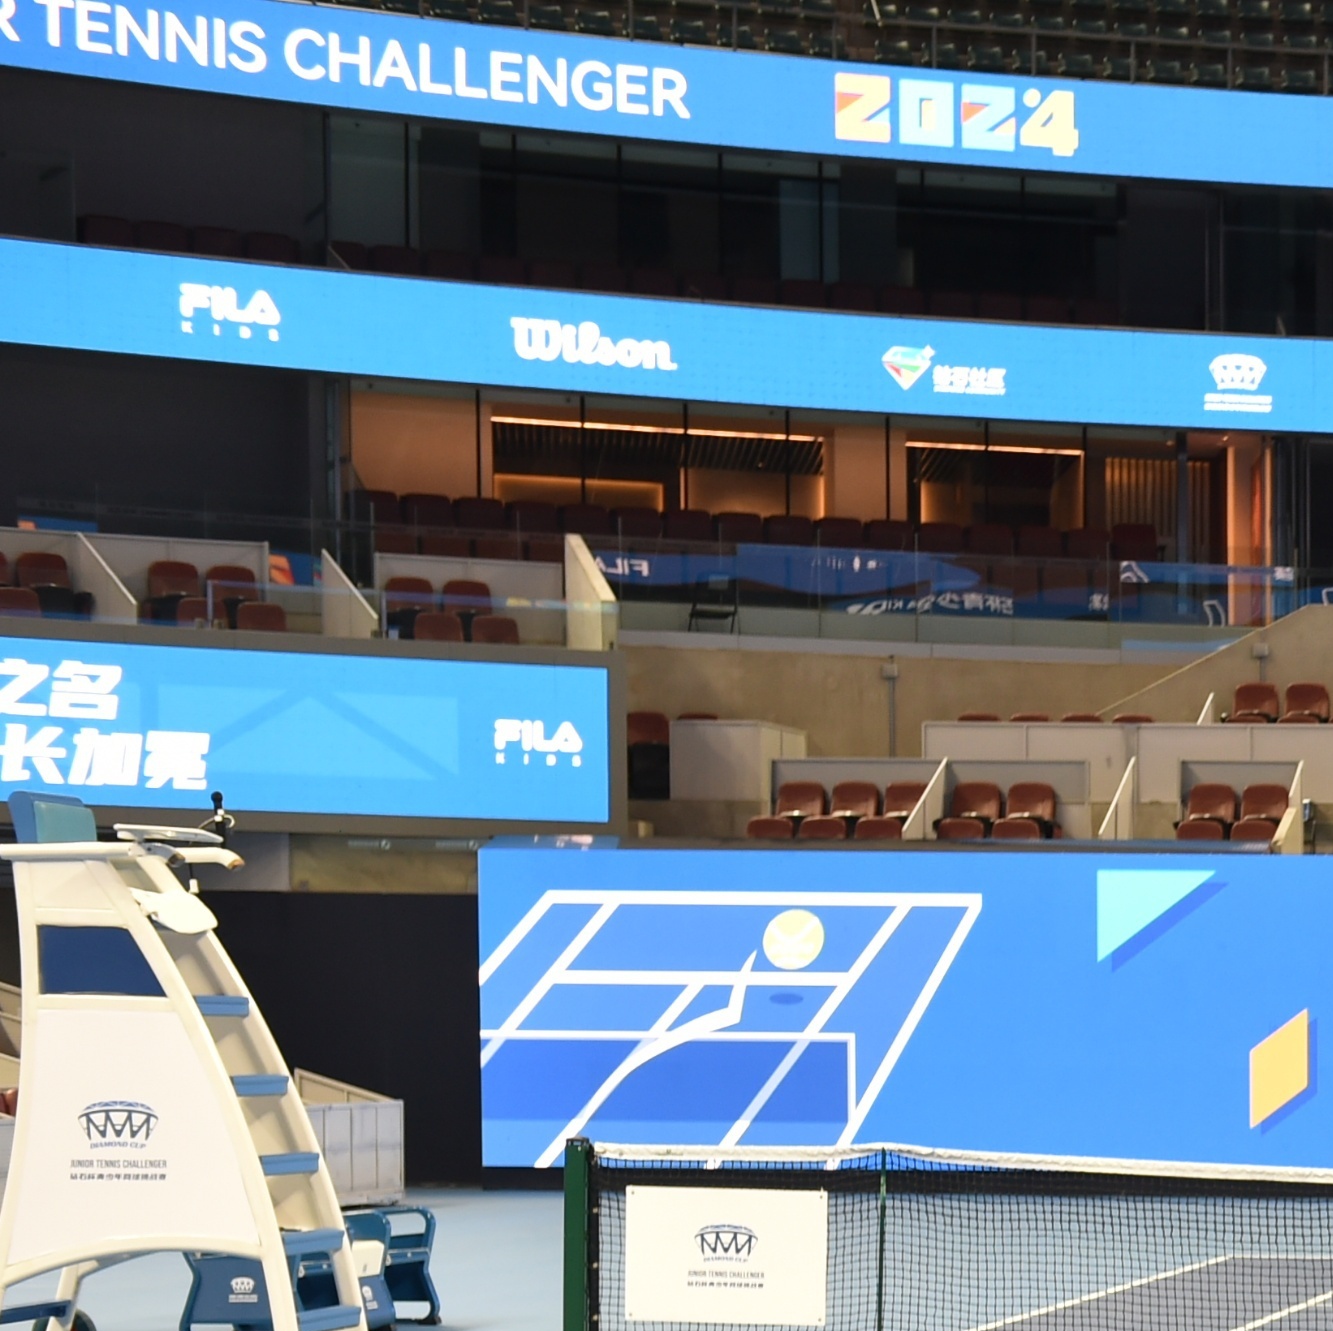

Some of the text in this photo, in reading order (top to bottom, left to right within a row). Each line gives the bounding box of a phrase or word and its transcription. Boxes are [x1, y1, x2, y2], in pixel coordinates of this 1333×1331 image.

[34, 0, 267, 73] TENNIS
[284, 28, 690, 119] CHALLENGER
[834, 72, 1079, 157] 2024
[180, 283, 281, 326] FILA
[510, 317, 678, 370] Wilson
[494, 719, 583, 753] FILA
[71, 1159, 167, 1168] JUNIOR TENNIS CHALLENGER
